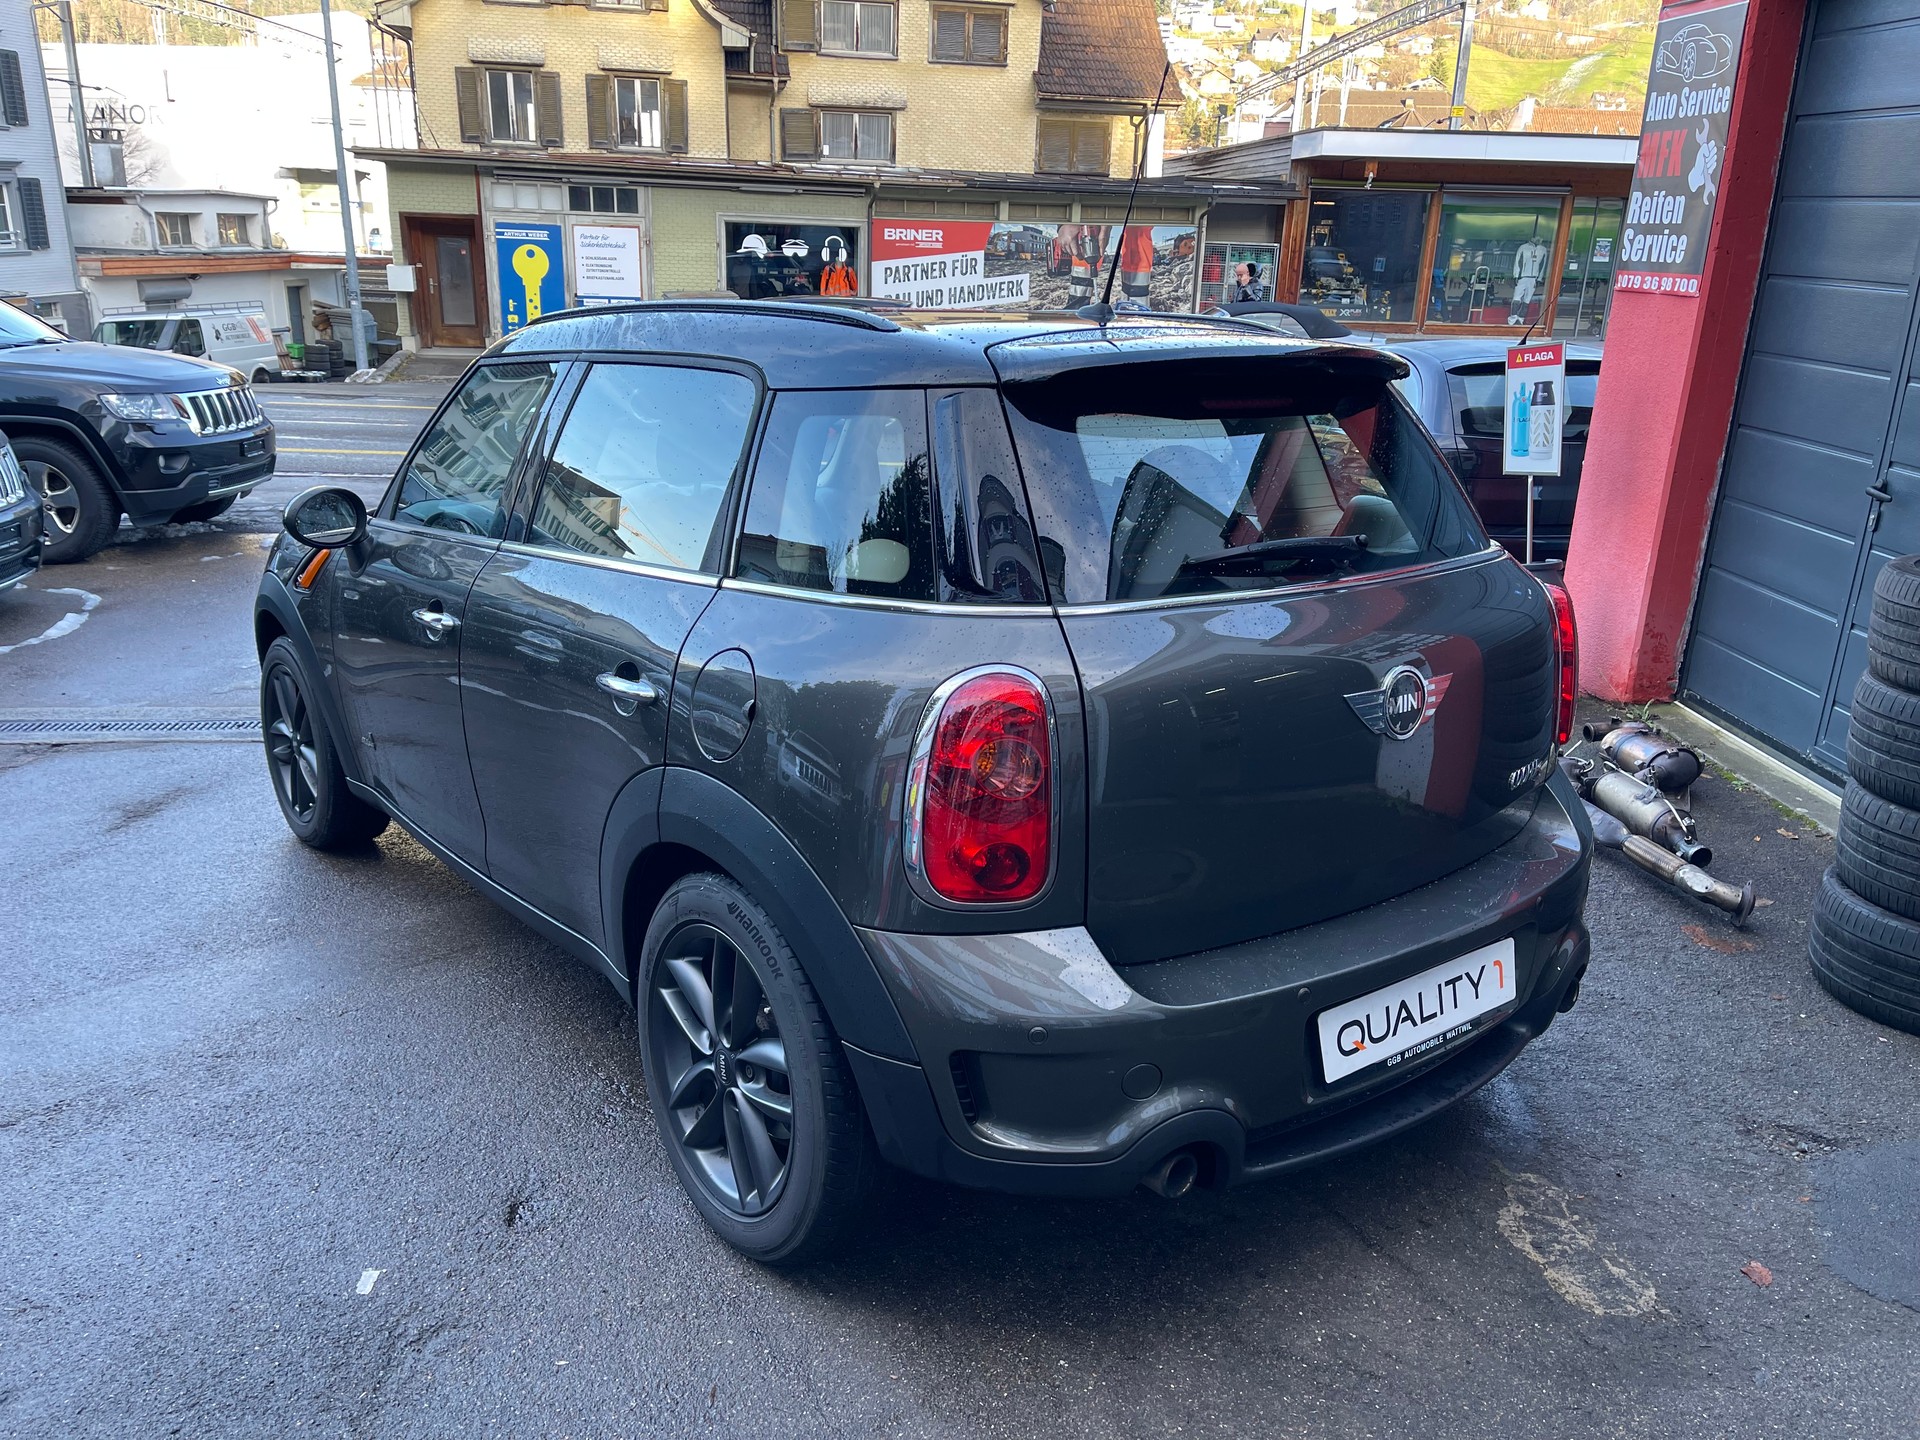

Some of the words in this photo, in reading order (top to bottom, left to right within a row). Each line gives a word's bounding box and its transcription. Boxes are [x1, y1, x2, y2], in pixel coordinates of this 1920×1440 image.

[1646, 91, 1676, 122] Auto
[1679, 83, 1730, 118] Service
[1627, 191, 1685, 224] Reifen
[884, 228, 943, 242] BRINER
[1621, 228, 1687, 264] Service
[884, 261, 947, 285] PARTNER
[951, 254, 978, 278] FÜR
[1621, 275, 1641, 289] 079
[1643, 276, 1659, 290] 36
[1661, 277, 1673, 291] 98
[1674, 278, 1697, 293] 700
[916, 289, 943, 308] UND
[948, 279, 1024, 305] HANDWERK
[1524, 351, 1554, 362] FLAGA
[1389, 691, 1422, 715] MINI
[1337, 964, 1486, 1057] QUALITY
[1493, 959, 1504, 989] 1
[1387, 1055, 1402, 1067] GGB
[1404, 1034, 1444, 1060] AUTOMOBILE
[1446, 1023, 1472, 1040] WATTWIL
[719, 1053, 727, 1084] MINI
